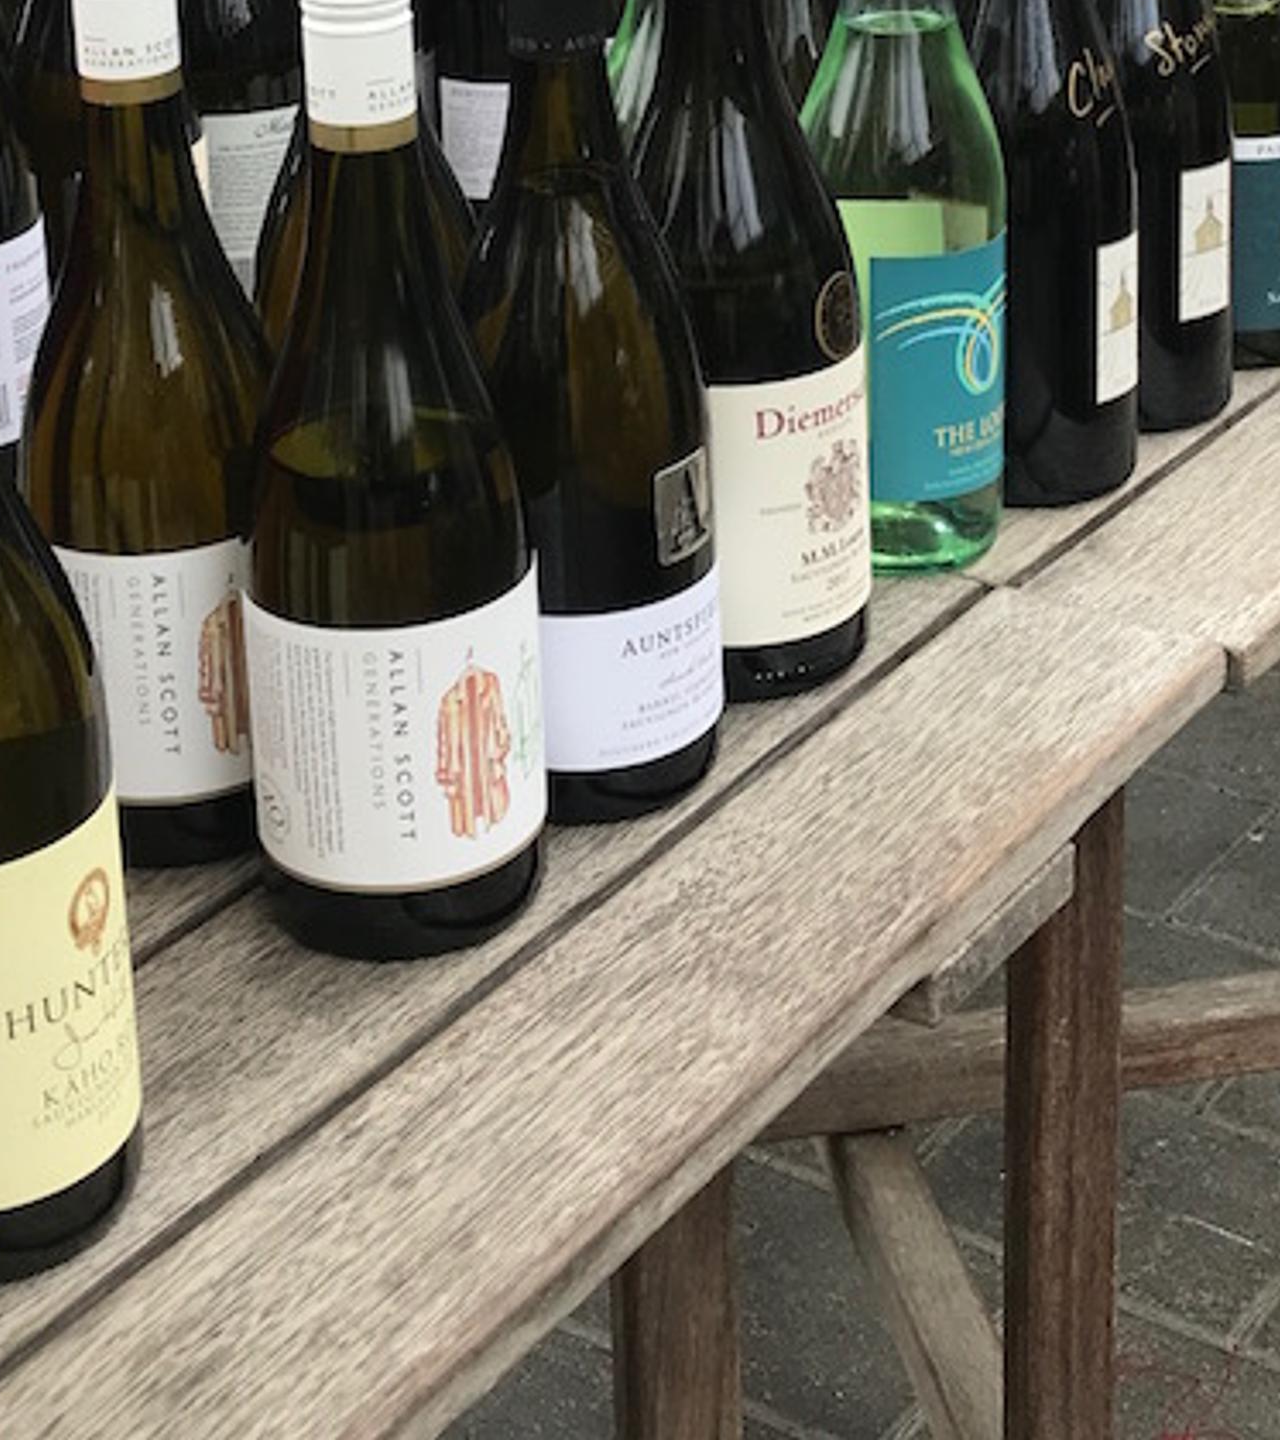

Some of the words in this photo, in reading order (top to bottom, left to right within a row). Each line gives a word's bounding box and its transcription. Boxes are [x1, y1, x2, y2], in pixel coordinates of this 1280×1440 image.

[933, 421, 975, 449] THE
[126, 575, 152, 727] GENERATIONS
[152, 573, 173, 658] ALLAN
[157, 672, 182, 756] SCOTT
[361, 650, 387, 811] GENERATIONS
[388, 648, 411, 737] ALLAN
[394, 752, 417, 840] SCOTT
